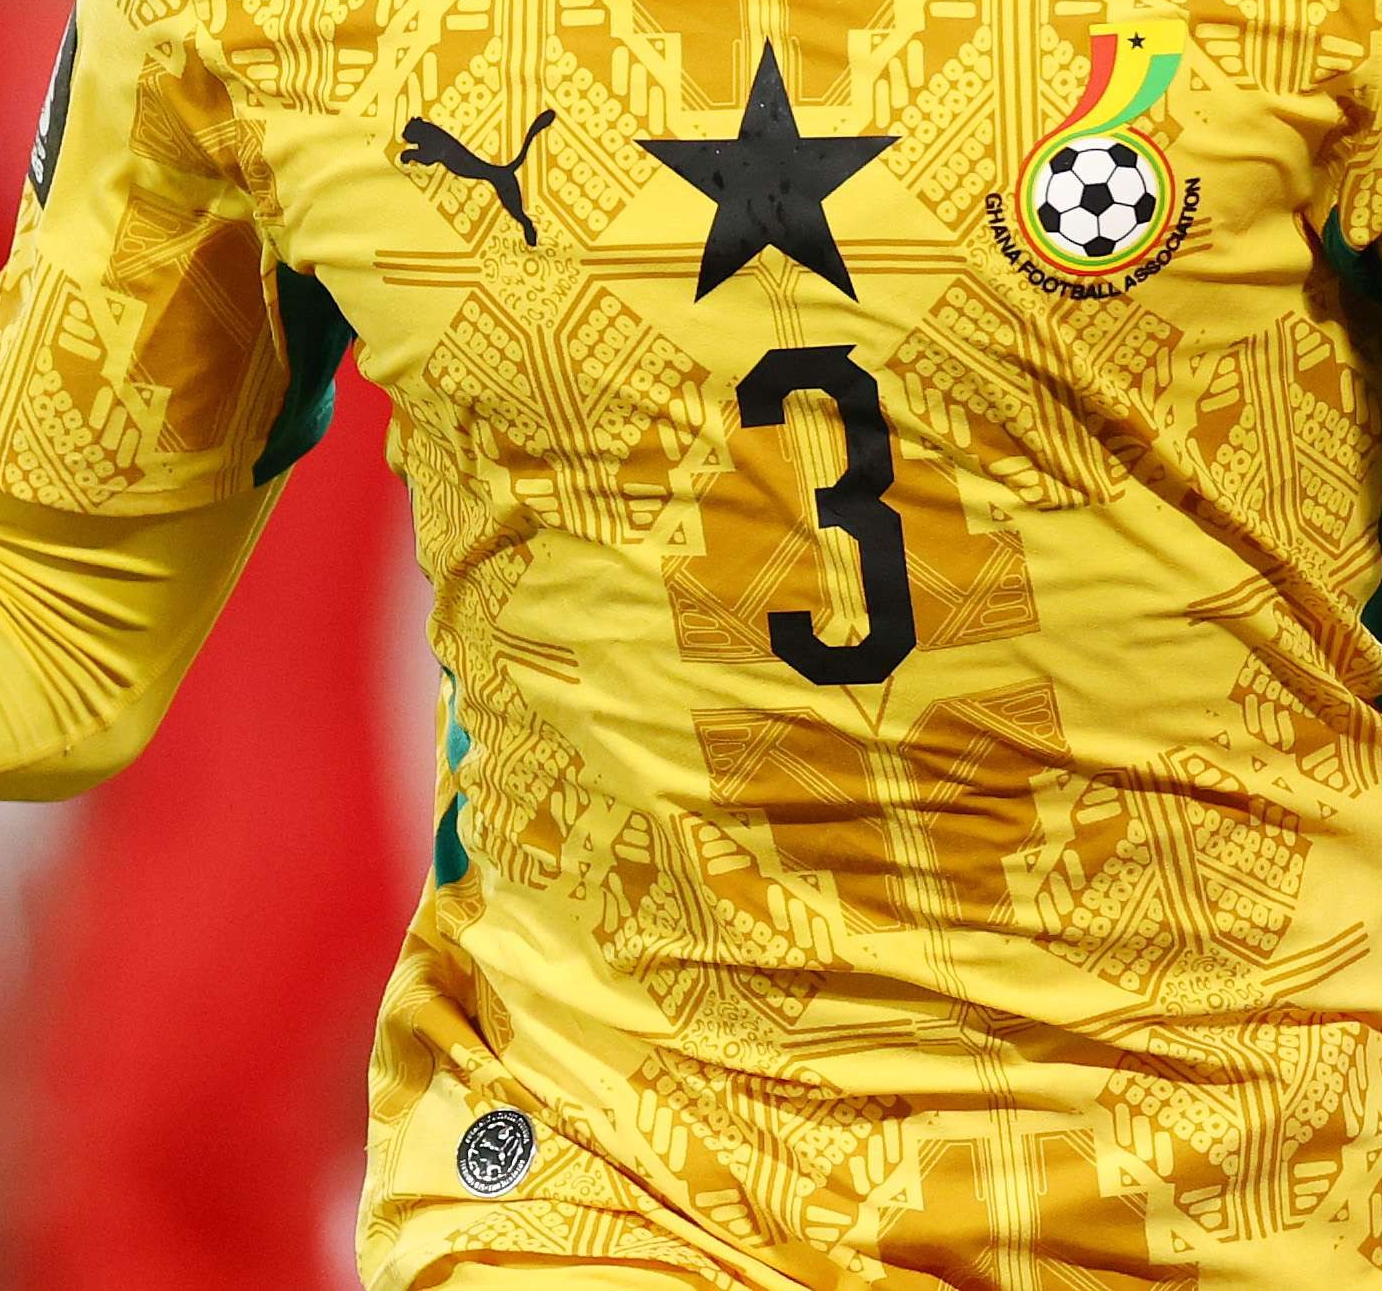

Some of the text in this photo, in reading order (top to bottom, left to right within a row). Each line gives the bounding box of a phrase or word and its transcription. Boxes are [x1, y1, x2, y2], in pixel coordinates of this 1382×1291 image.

[984, 176, 1201, 301] GHANA FOOTBALL ASSOCIATION
[735, 344, 917, 686] 3
